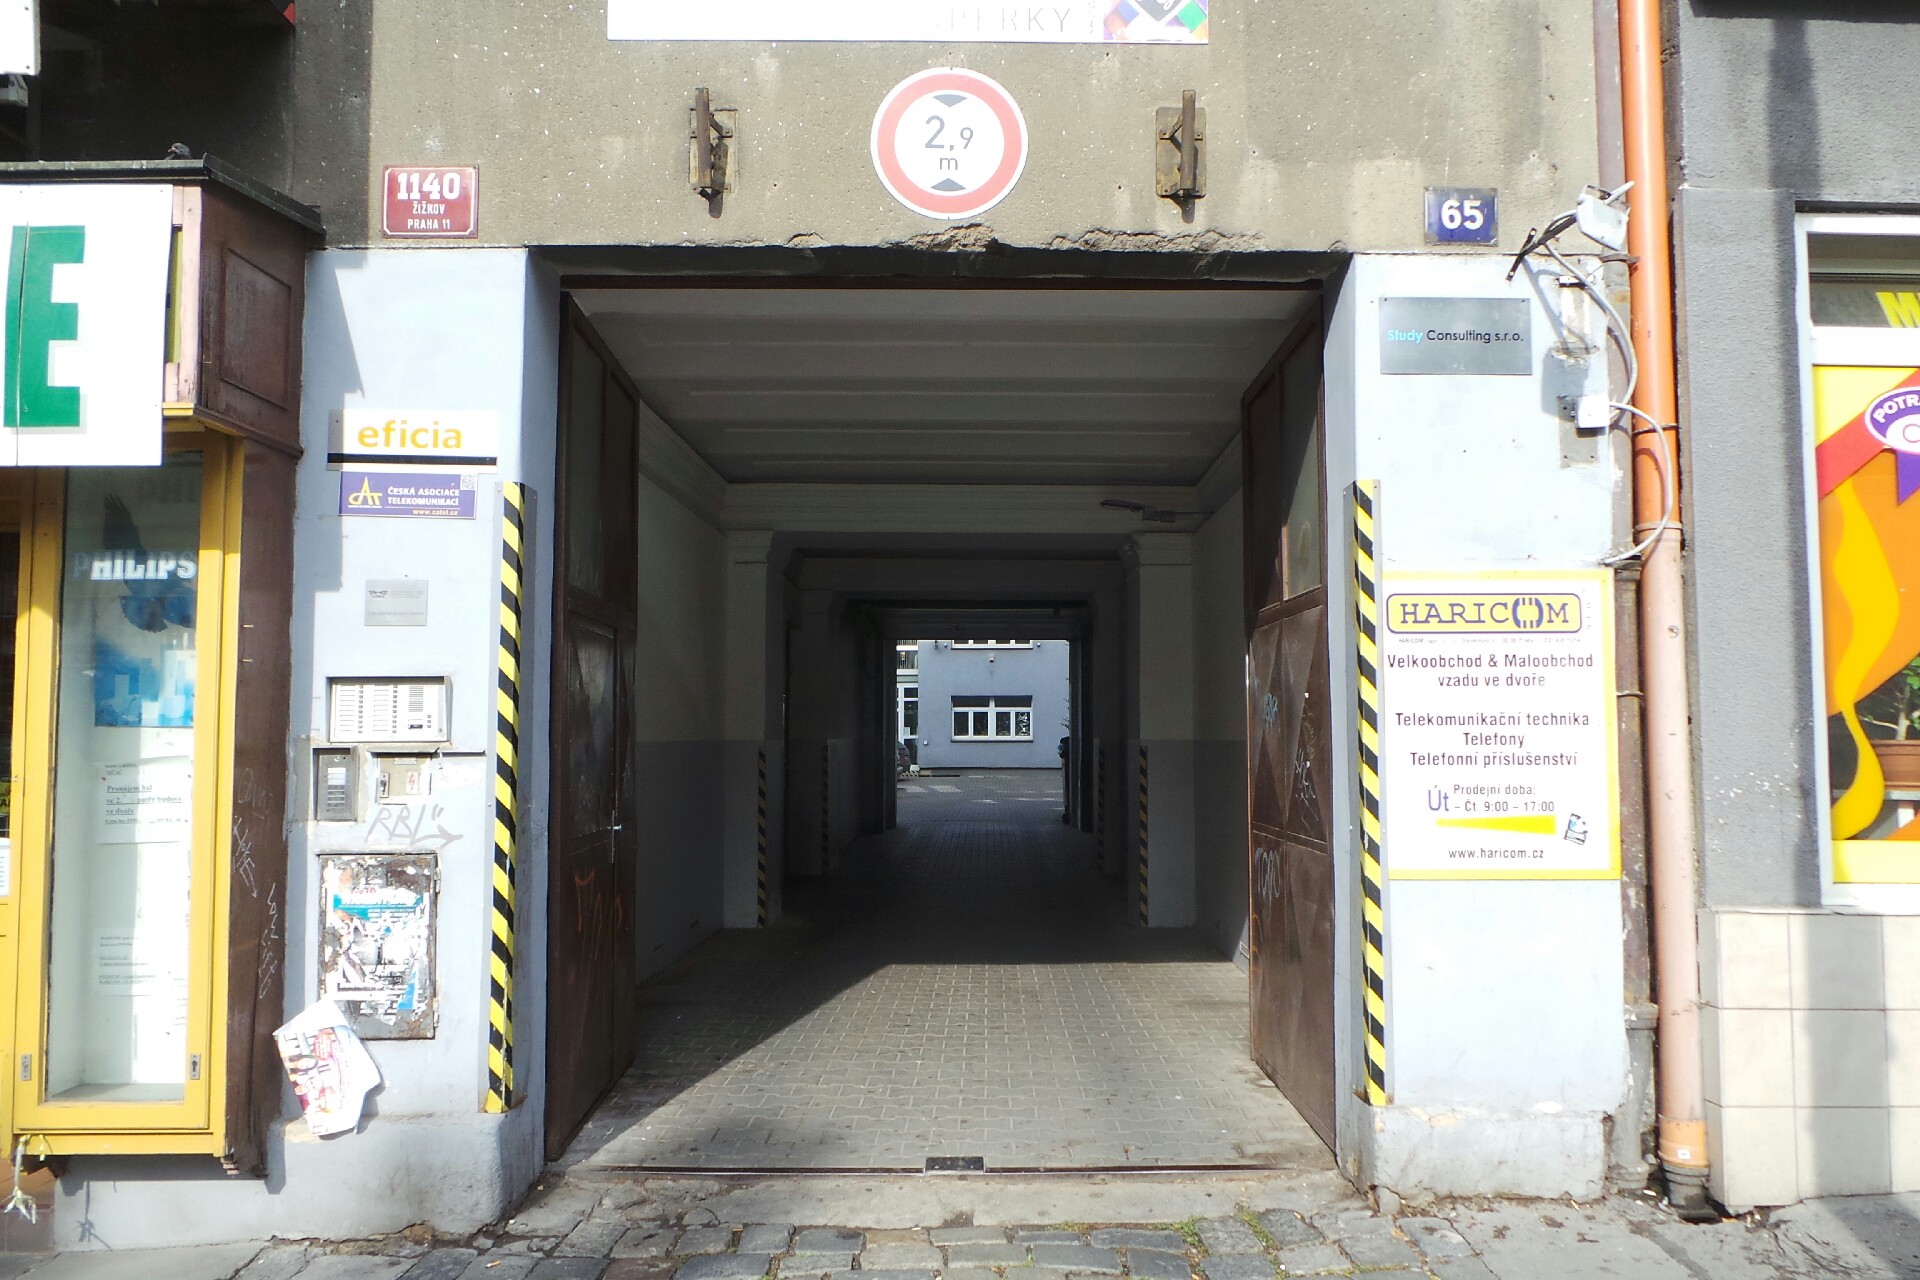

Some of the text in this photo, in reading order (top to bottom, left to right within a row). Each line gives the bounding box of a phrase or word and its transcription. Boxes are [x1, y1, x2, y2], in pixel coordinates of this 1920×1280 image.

[925, 115, 973, 151] 2,9
[940, 157, 958, 170] m
[397, 172, 461, 200] 1140
[412, 200, 446, 214] ŽIŽKOV
[1441, 199, 1484, 230] 65
[407, 219, 439, 230] PRAHA
[3, 225, 86, 428] E
[1387, 329, 1524, 344] Study Consulting s.r.o.
[1872, 394, 1920, 424] POTR
[357, 419, 463, 449] eficia
[387, 485, 460, 497] ČESKÁ ASOCIACE
[387, 496, 459, 506] TELEKOMUNIKACÍ
[72, 550, 197, 580] PHILIPS
[1400, 597, 1569, 628] HARICOM
[1387, 654, 1593, 668] Velkoobchod & Maloobchod
[1438, 672, 1546, 687] vzadu ve dvoře
[1395, 711, 1589, 726] Telekomunikační technika
[1463, 732, 1525, 748] Telefony
[1410, 752, 1578, 768] Telefonní příslušenství
[1453, 784, 1536, 797] Prodejní doba:
[1428, 785, 1449, 811] Út
[1464, 799, 1477, 811] Čt
[1484, 801, 1509, 812] 9:00
[1524, 801, 1555, 812] 17:00
[1449, 848, 1544, 859] www.haricom.cz
